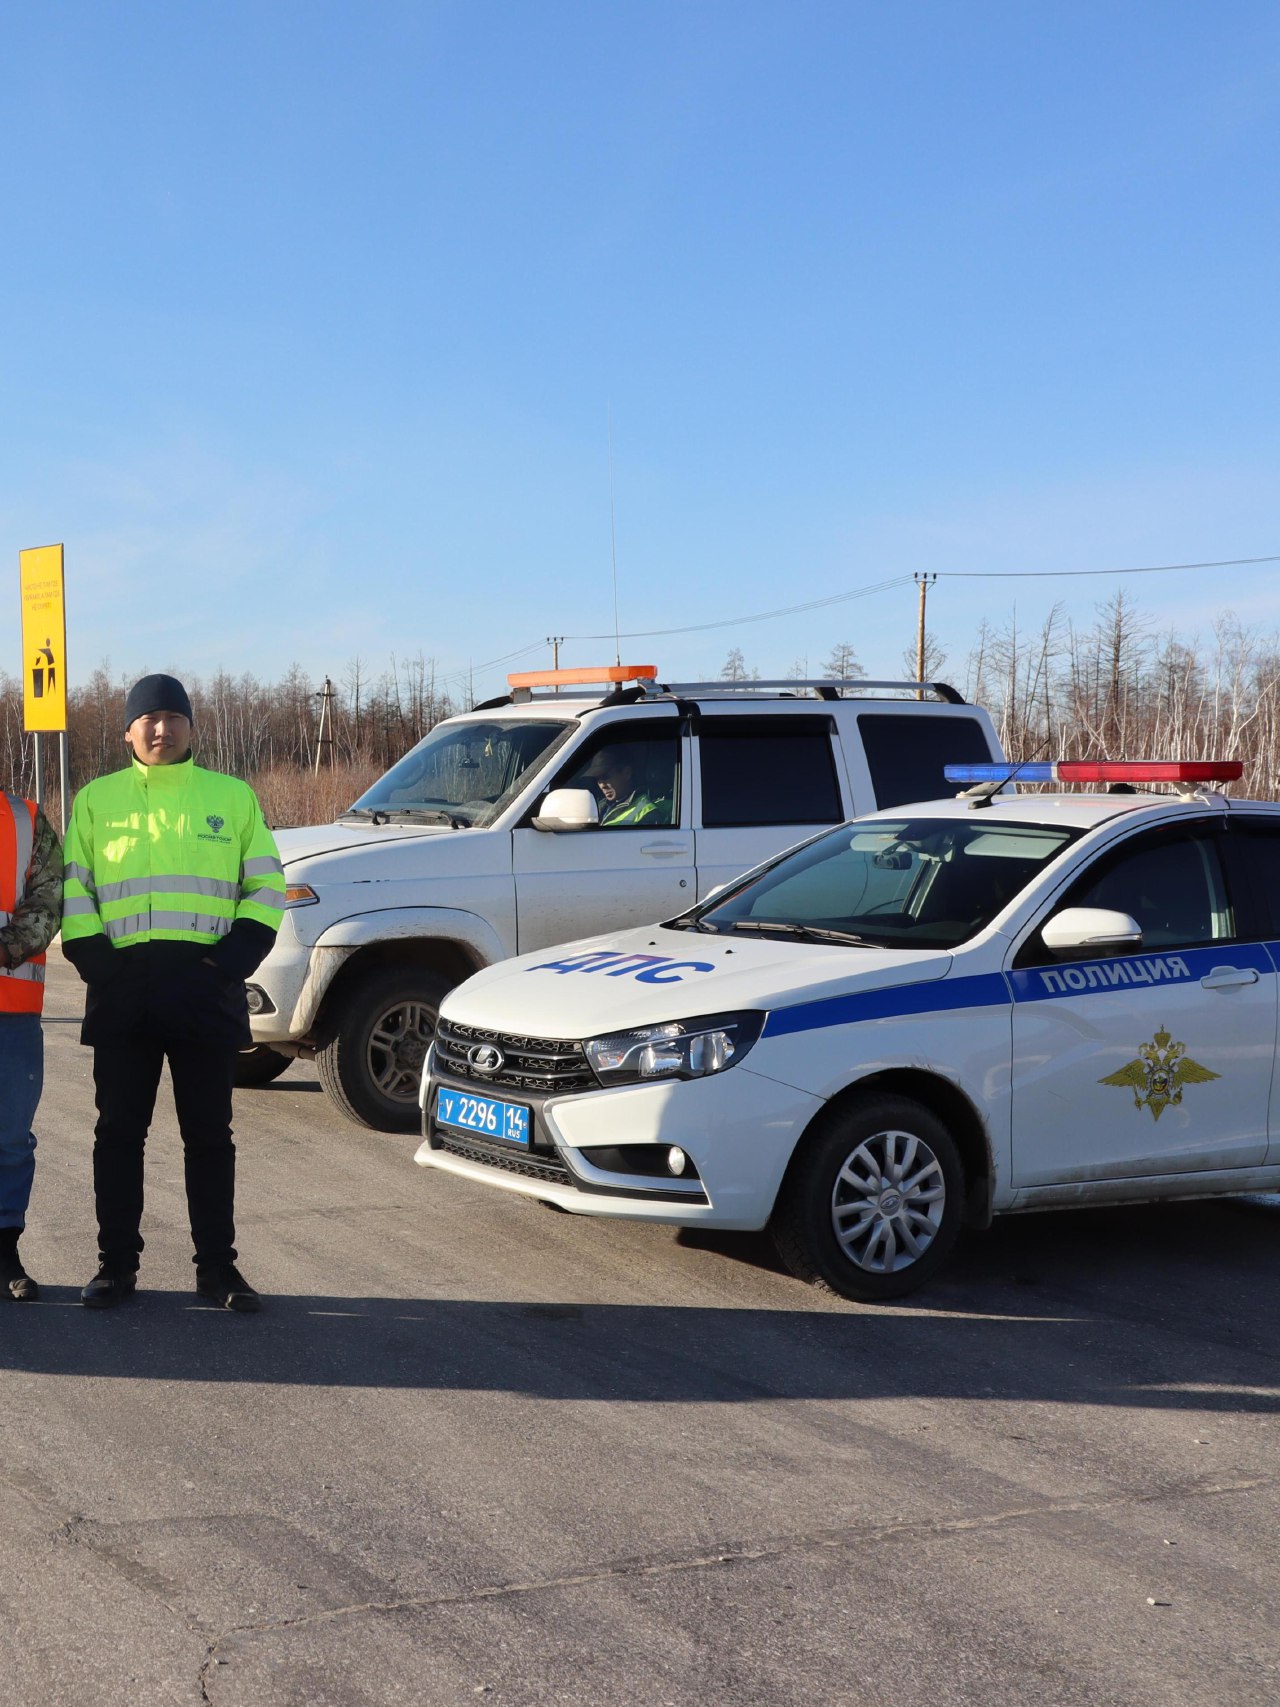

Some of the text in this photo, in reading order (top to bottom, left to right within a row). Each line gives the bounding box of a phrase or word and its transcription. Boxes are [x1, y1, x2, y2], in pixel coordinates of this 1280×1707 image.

[523, 952, 715, 983] ДПС
[1039, 957, 1190, 992] ПОЛИЦИЯ
[458, 1097, 496, 1130] 2296
[507, 1107, 522, 1131] 14
[507, 1129, 520, 1139] RUS
